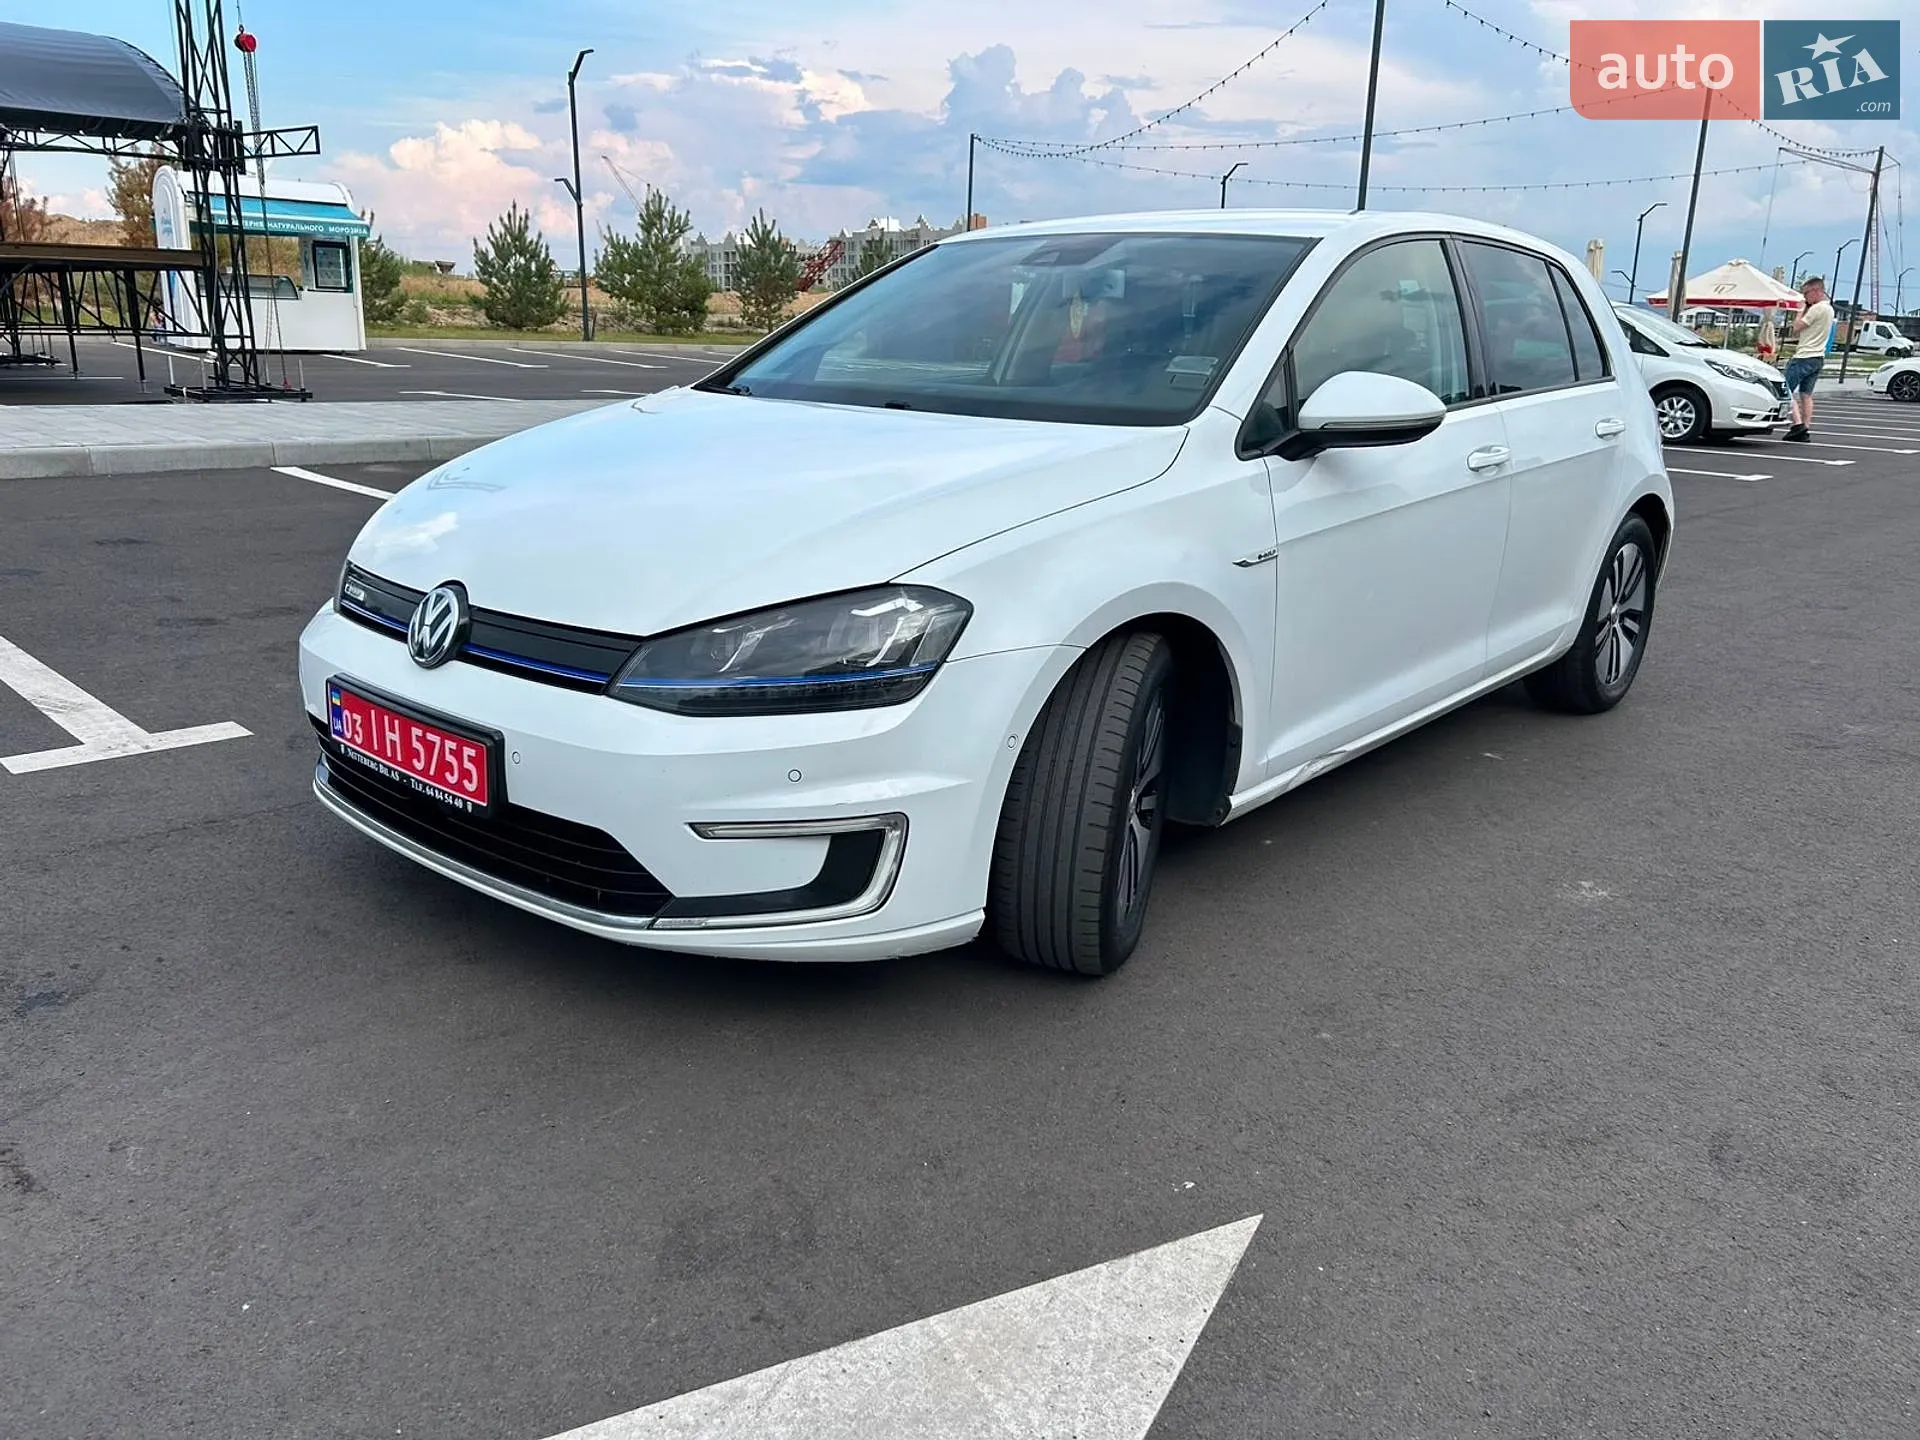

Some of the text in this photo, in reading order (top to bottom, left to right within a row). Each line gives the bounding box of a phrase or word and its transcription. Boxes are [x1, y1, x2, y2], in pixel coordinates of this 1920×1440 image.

[267, 221, 325, 233] НАТУРАЛЬНОГО
[333, 717, 343, 733] UA
[342, 709, 364, 745] 03
[411, 726, 478, 792] 5755
